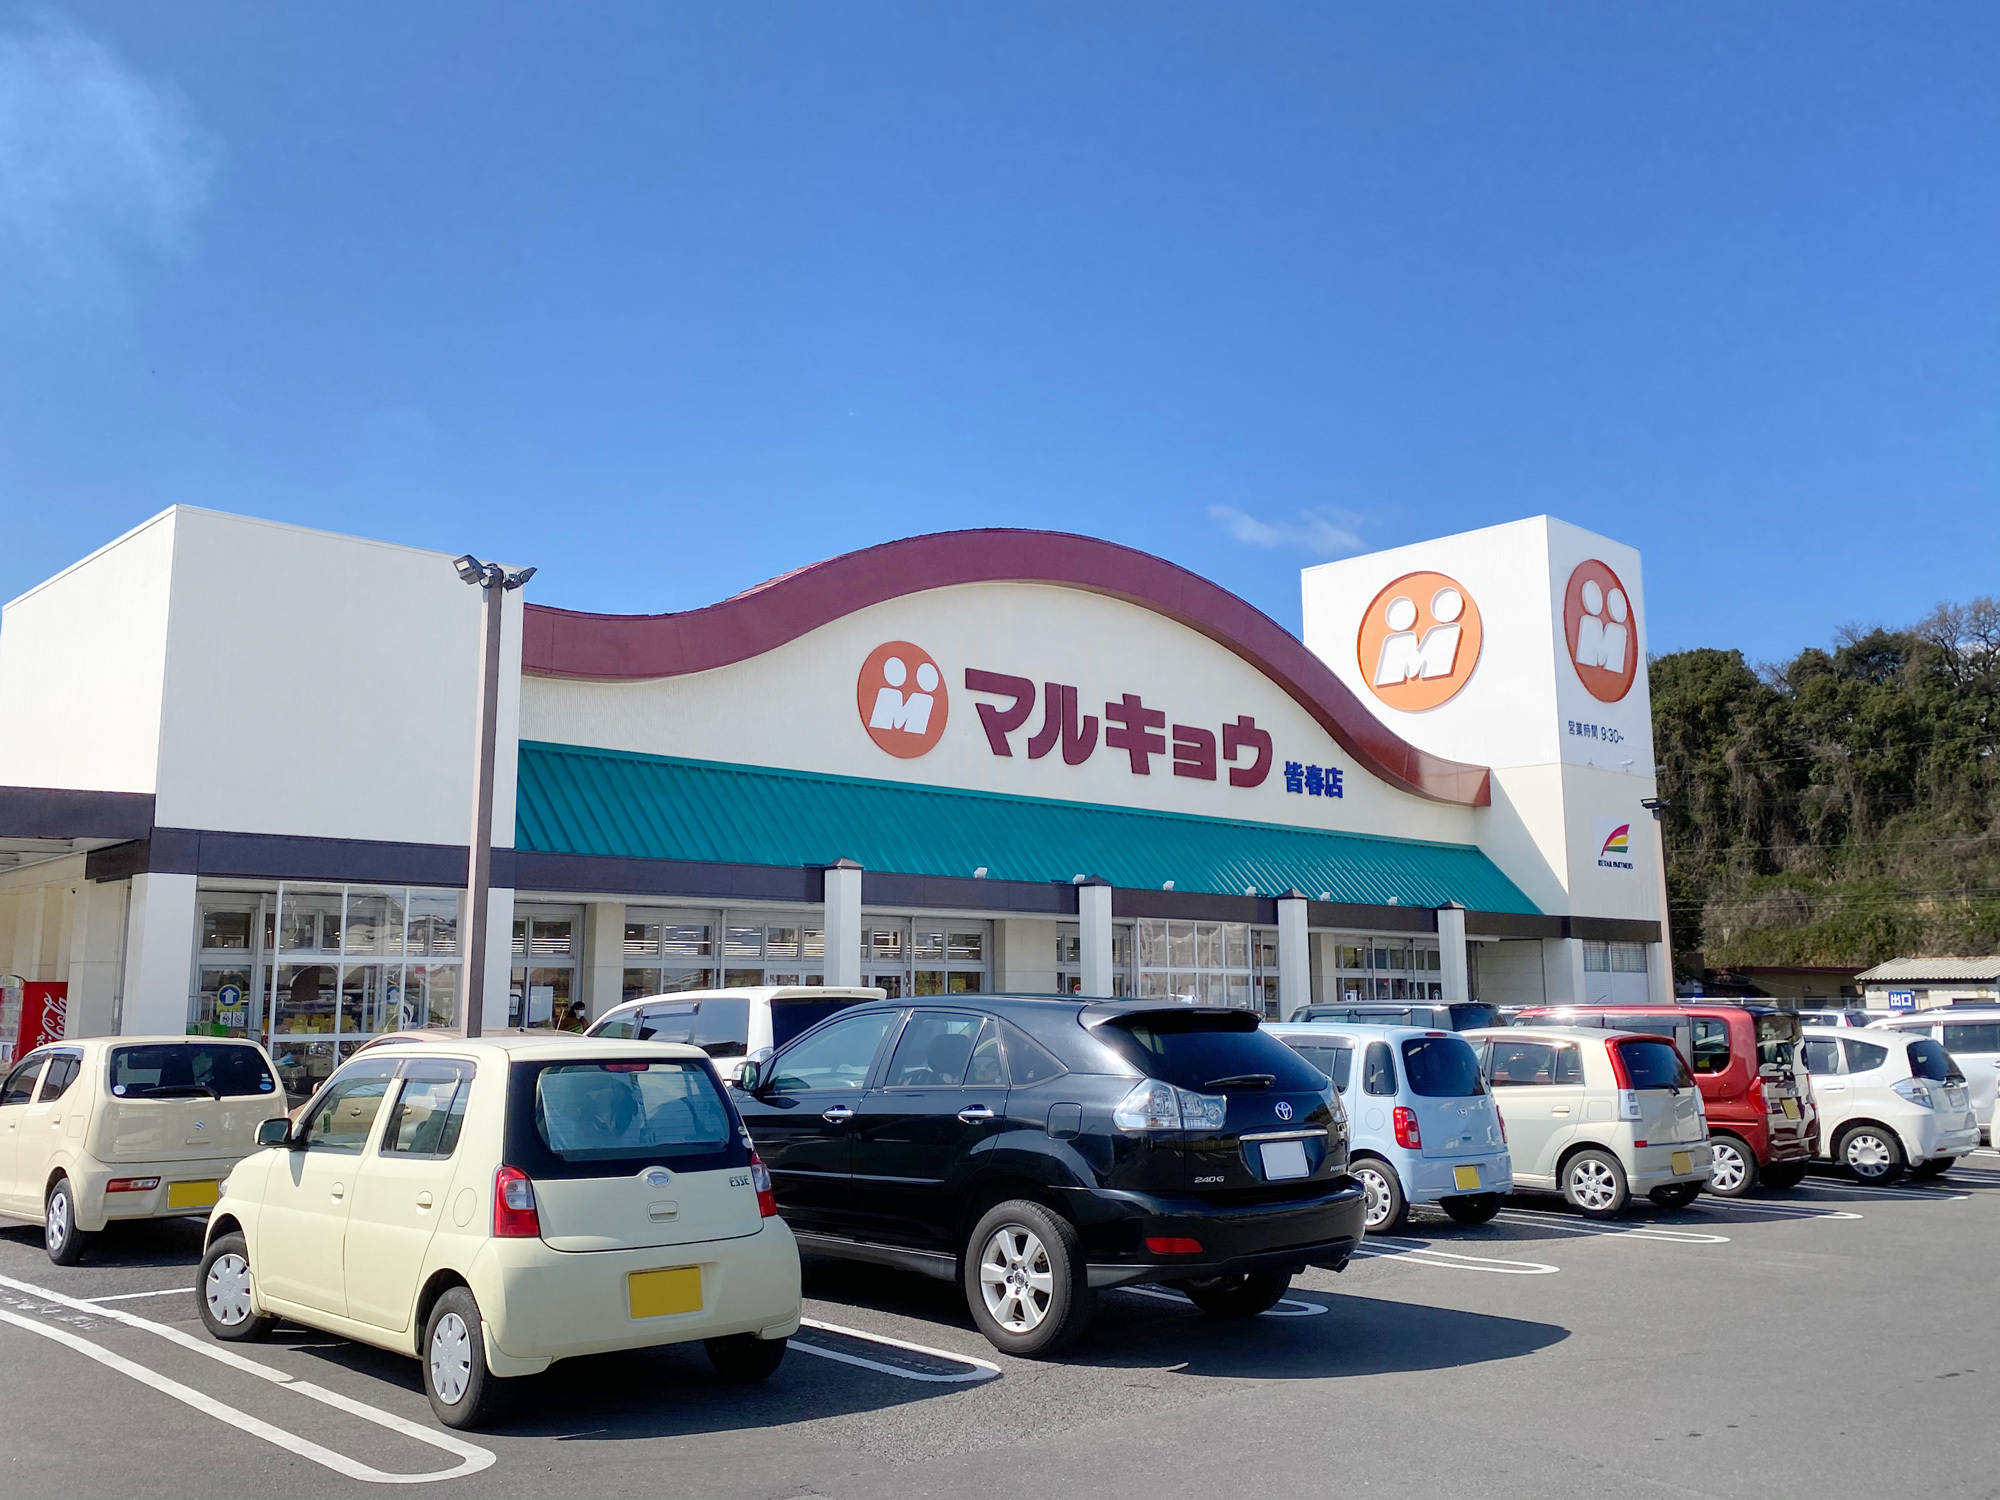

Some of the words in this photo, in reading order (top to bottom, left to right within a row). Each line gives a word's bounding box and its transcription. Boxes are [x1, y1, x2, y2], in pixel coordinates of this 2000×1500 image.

[965, 667, 1273, 788] マルキョウ
[1568, 720, 1598, 739] 営業時間
[1284, 761, 1343, 799] 皆春店
[1890, 993, 1912, 1006] 出口
[729, 1174, 750, 1187] ESSE
